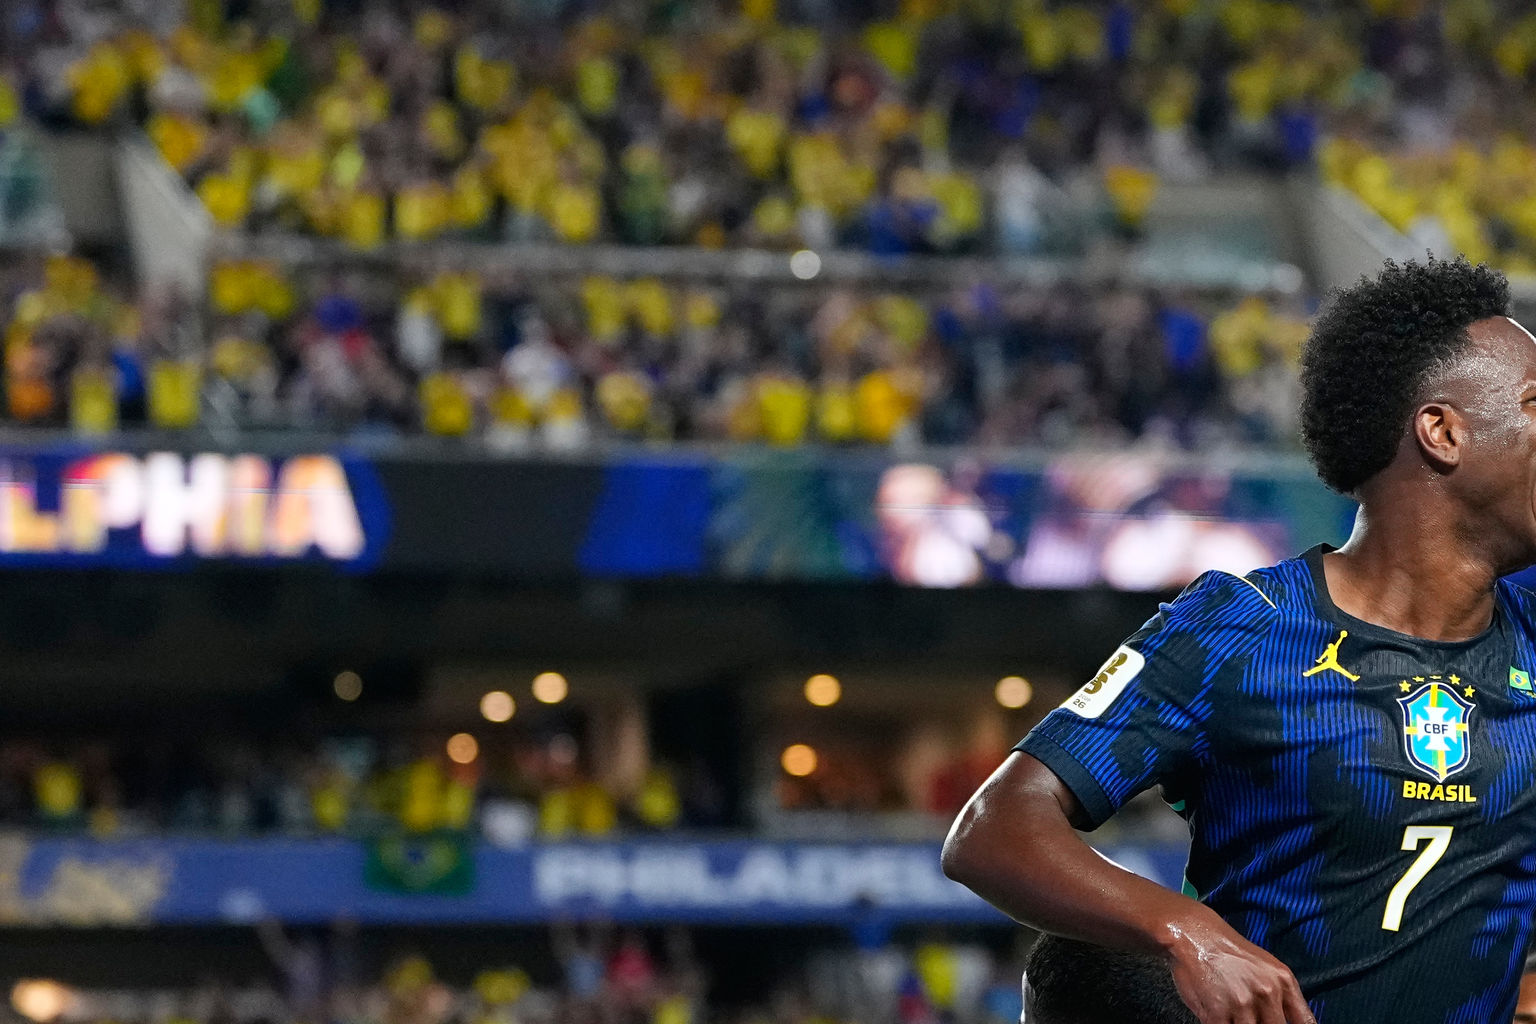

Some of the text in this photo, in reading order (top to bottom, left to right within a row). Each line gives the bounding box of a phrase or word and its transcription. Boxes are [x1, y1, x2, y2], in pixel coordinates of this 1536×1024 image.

[1423, 722, 1449, 735] CBF
[1402, 780, 1477, 803] BRASIL
[535, 845, 1150, 903] PHILADEL
[1381, 825, 1454, 932] 7
